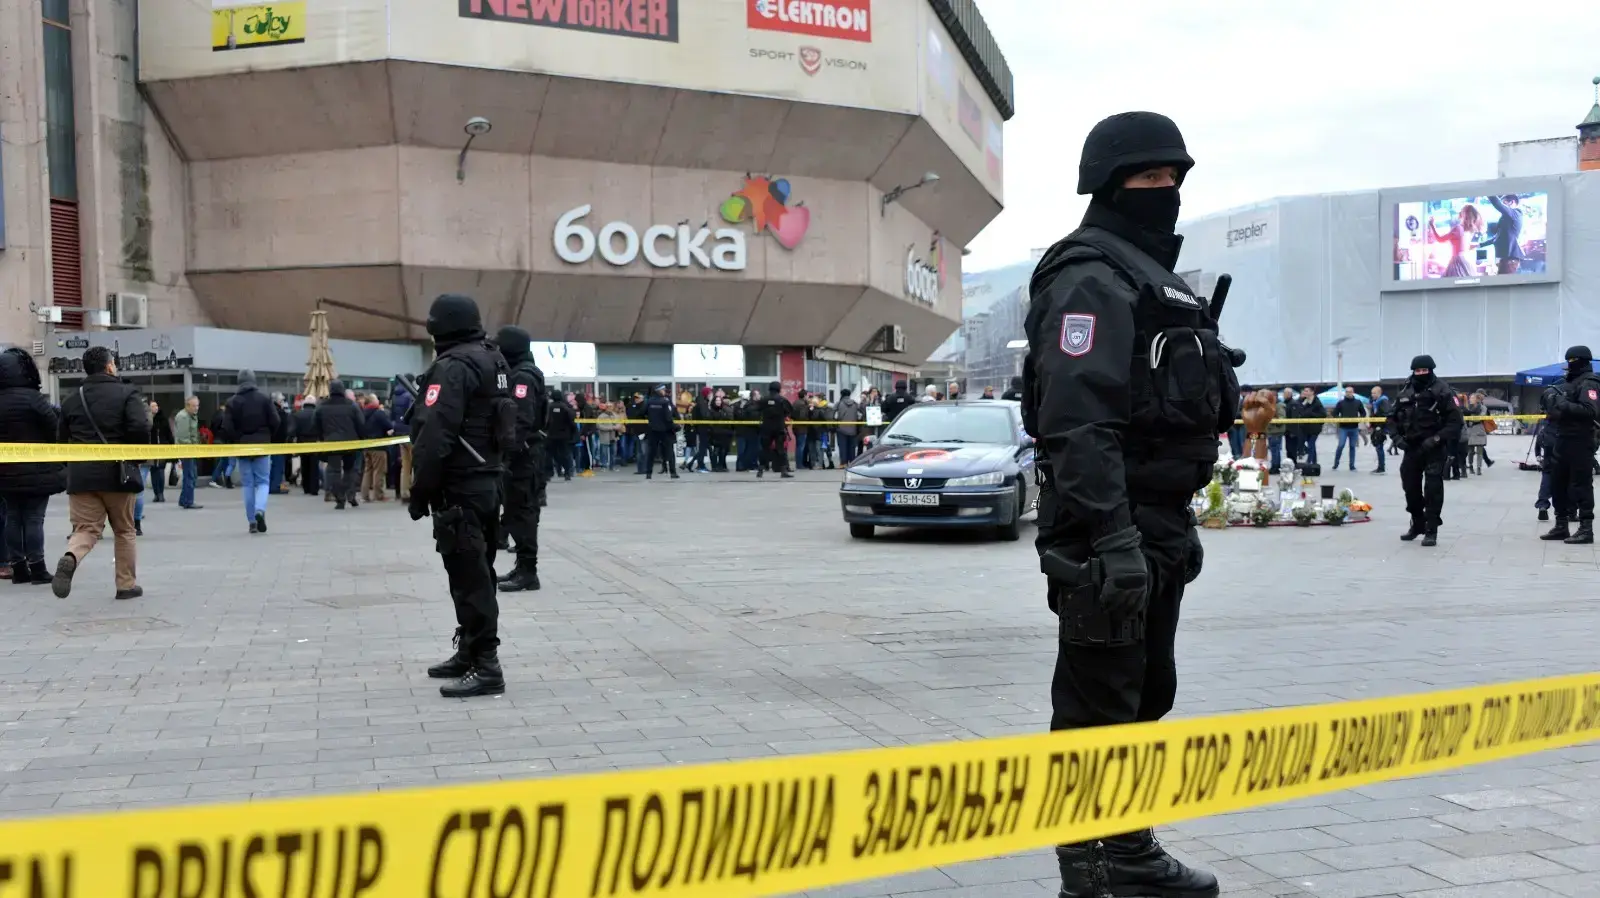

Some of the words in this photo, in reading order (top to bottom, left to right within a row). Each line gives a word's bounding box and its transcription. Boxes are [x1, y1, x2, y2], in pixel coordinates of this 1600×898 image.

[749, 48, 795, 60] SPORT
[825, 58, 867, 70] VISION
[554, 204, 747, 270] боска
[892, 494, 937, 504] K15-M-451
[427, 803, 567, 898] СТОП
[589, 774, 836, 898] ПОЛИЦИЈА
[853, 754, 1030, 859] ЗАБРАЊЕН
[1034, 740, 1168, 830] ПРИСТУП
[1171, 732, 1232, 808] STOP
[1232, 721, 1318, 795] POLICIJA
